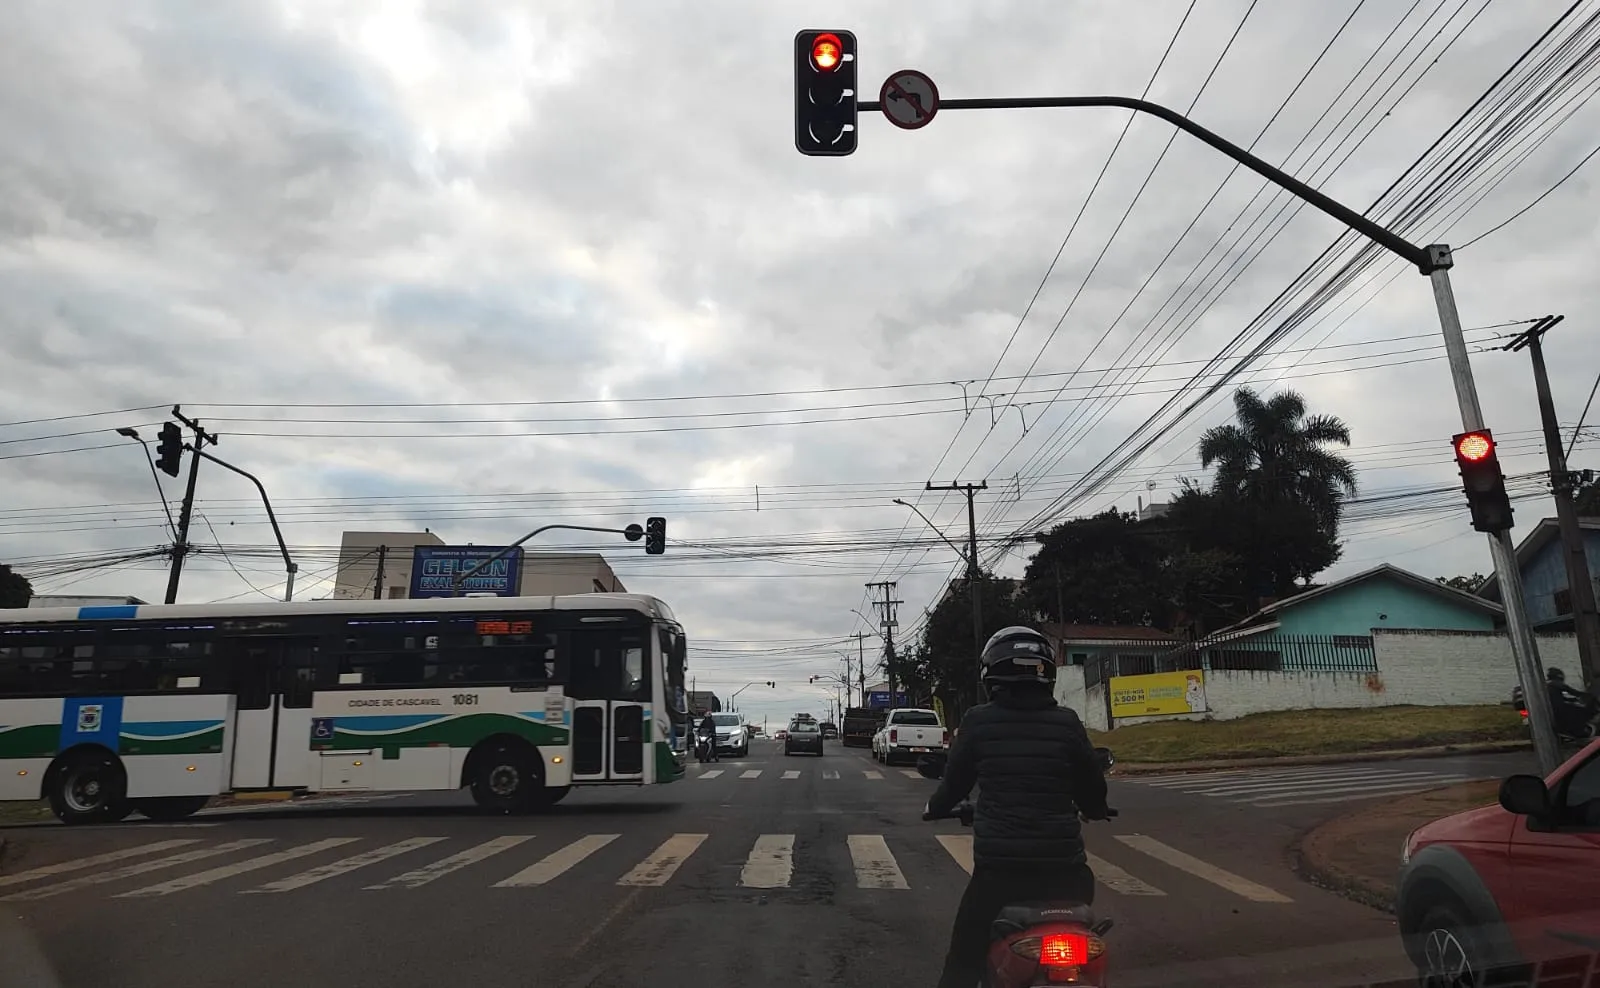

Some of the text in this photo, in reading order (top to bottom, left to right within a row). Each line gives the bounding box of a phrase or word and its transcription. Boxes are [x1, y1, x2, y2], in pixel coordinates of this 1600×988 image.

[423, 559, 508, 576] GELSON
[382, 699, 394, 707] DE
[395, 698, 442, 706] CASCAVEL
[452, 694, 479, 705] 1081
